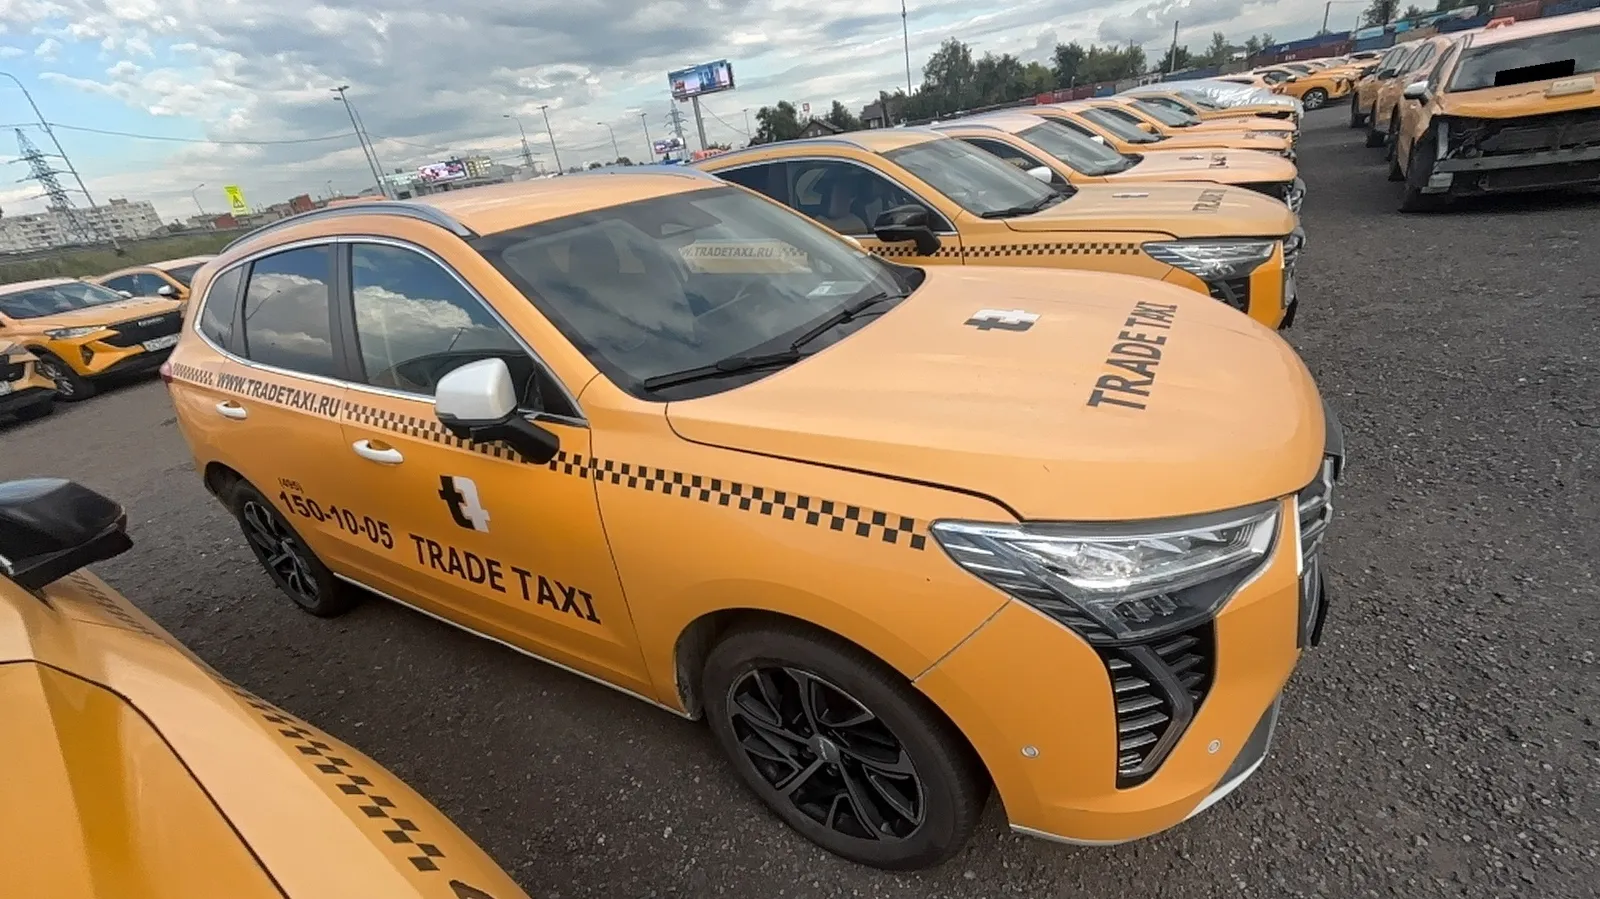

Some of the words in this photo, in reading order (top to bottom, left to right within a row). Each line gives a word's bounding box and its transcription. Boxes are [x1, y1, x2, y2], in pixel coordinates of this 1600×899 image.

[1124, 301, 1178, 329] TAXI
[216, 373, 342, 417] WWW.TRADETAXI.RU
[1086, 331, 1167, 410] TRADE
[279, 490, 394, 549] 150-10-05
[408, 533, 506, 593] TRADE
[511, 566, 602, 625] TAXI
